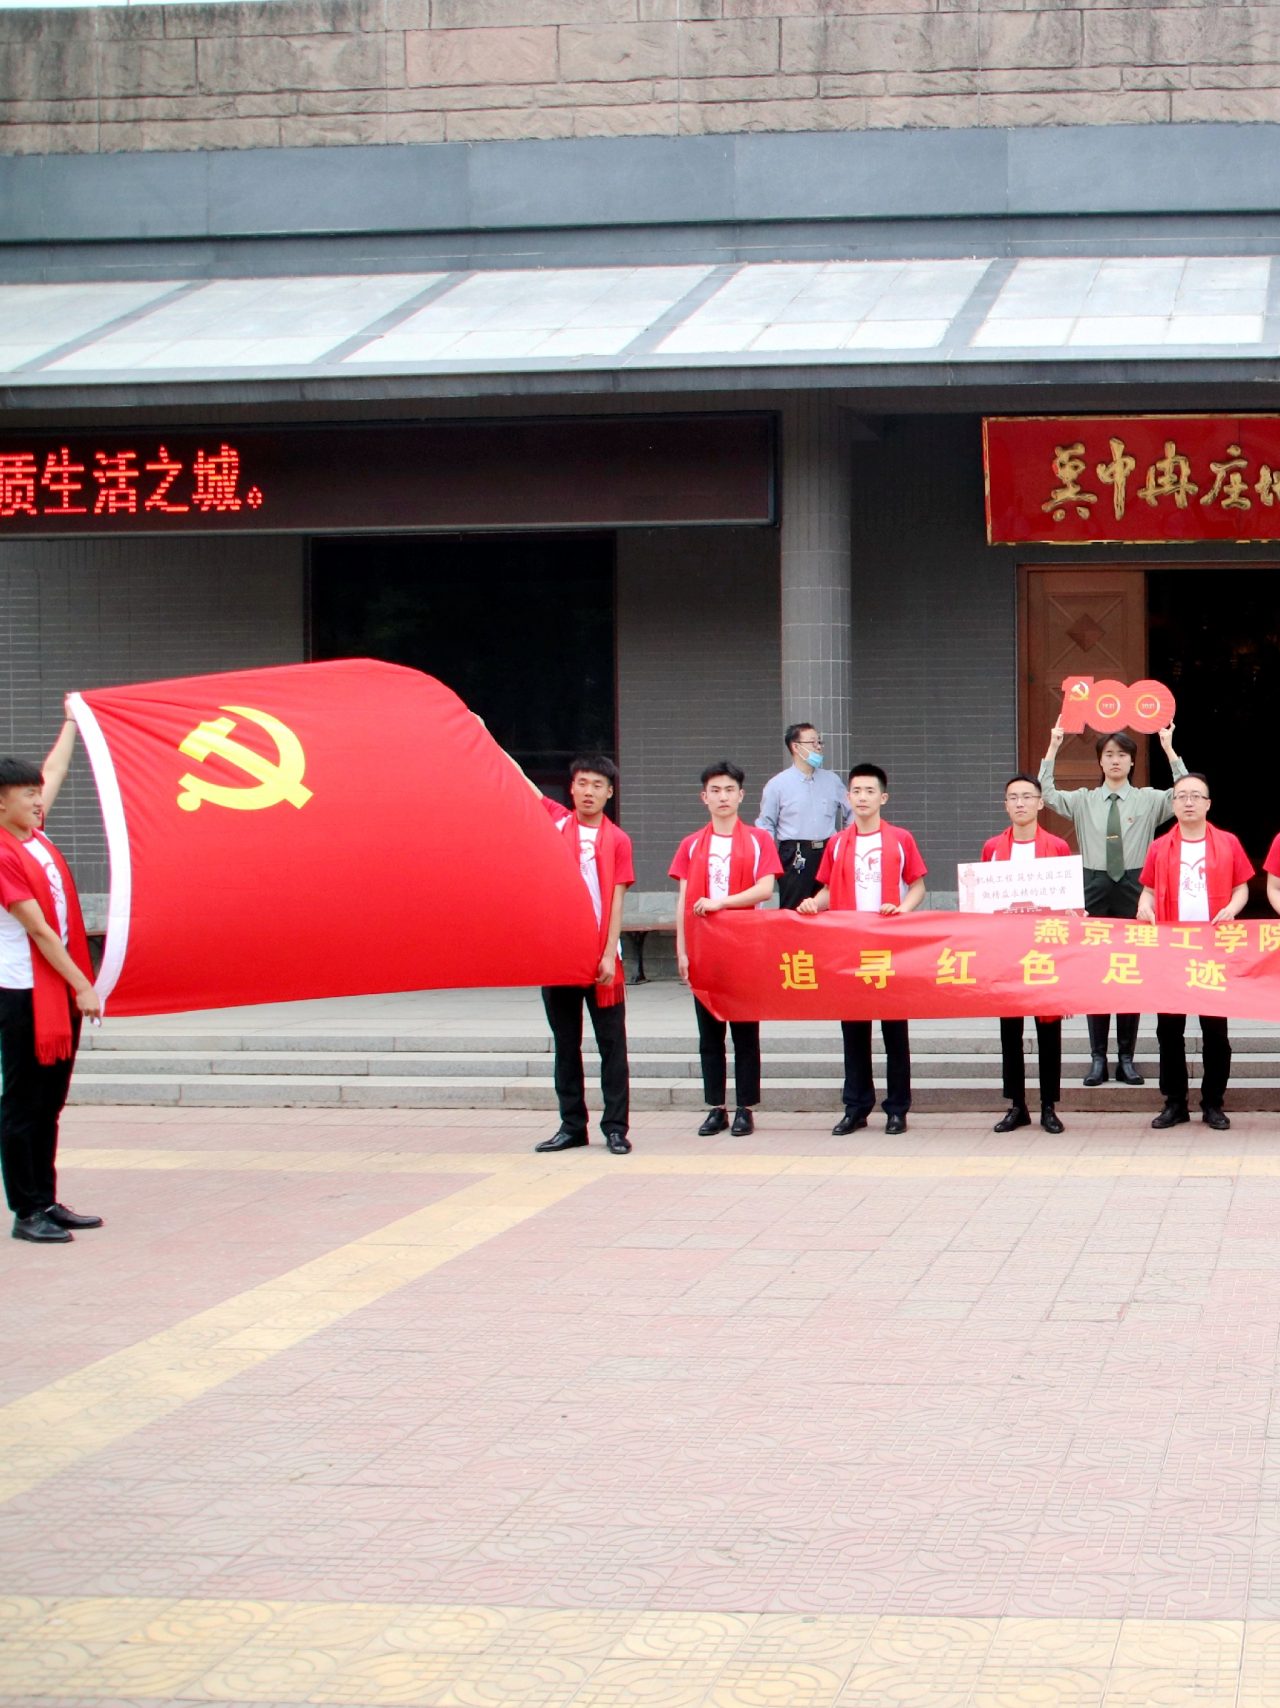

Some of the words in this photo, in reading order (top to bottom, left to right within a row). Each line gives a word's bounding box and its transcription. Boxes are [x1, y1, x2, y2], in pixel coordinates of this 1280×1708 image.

[779, 946, 1228, 992] 追寻红色足迹
